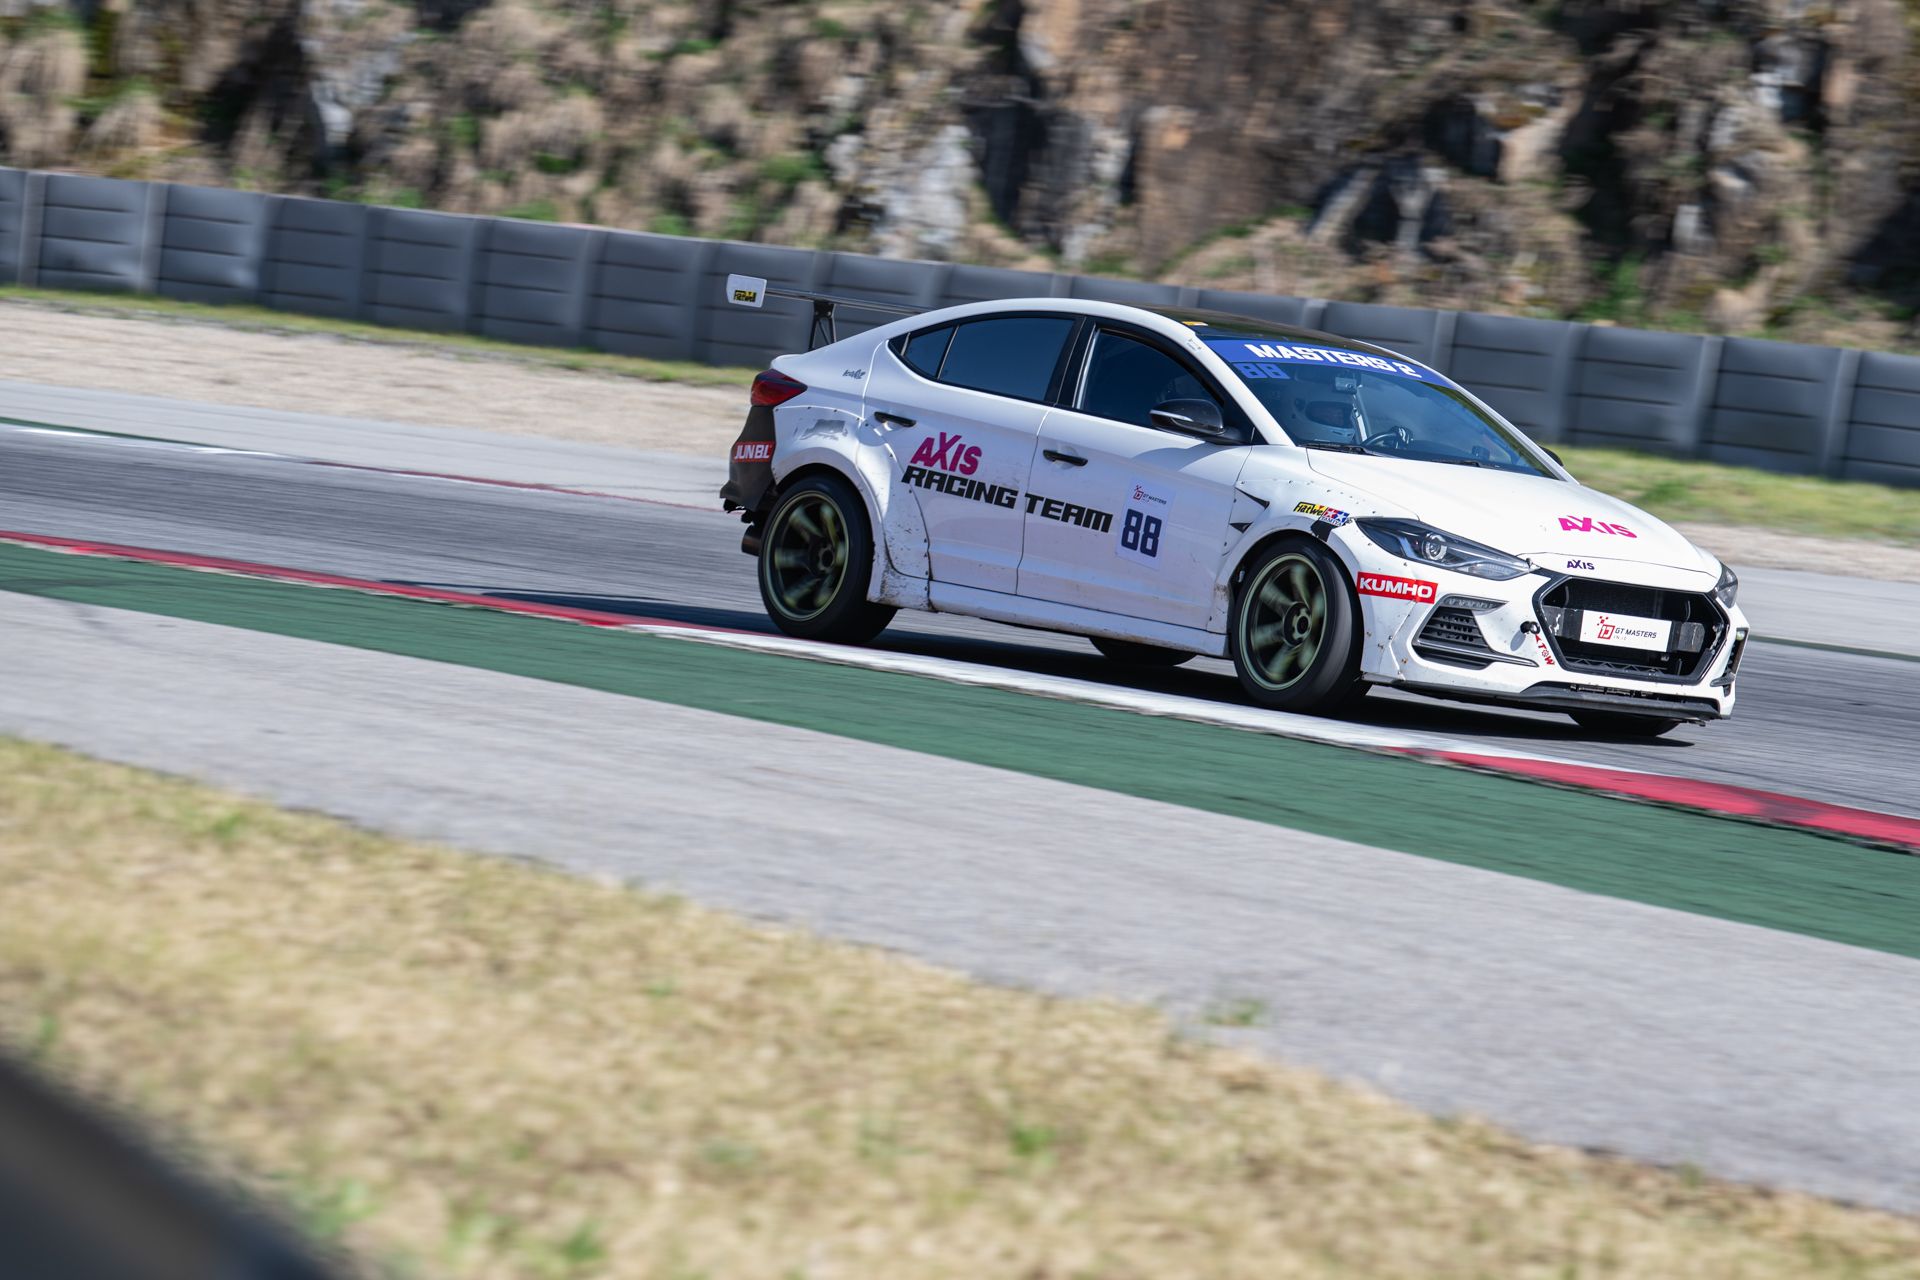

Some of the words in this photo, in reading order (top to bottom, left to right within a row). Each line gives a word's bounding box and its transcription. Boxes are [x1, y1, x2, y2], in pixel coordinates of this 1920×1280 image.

[1231, 363, 1291, 379] 88
[1244, 343, 1397, 373] MASTERS
[1391, 361, 1422, 378] 2
[909, 431, 983, 476] AXIS
[901, 464, 1019, 509] RACING
[1024, 492, 1114, 534] TEAM
[1121, 508, 1162, 558] 88
[1558, 515, 1638, 538] AXIS
[1566, 559, 1595, 570] AXIS
[1360, 577, 1433, 599] KUMHO
[1615, 627, 1626, 635] GT
[1625, 628, 1658, 639] MASTERS
